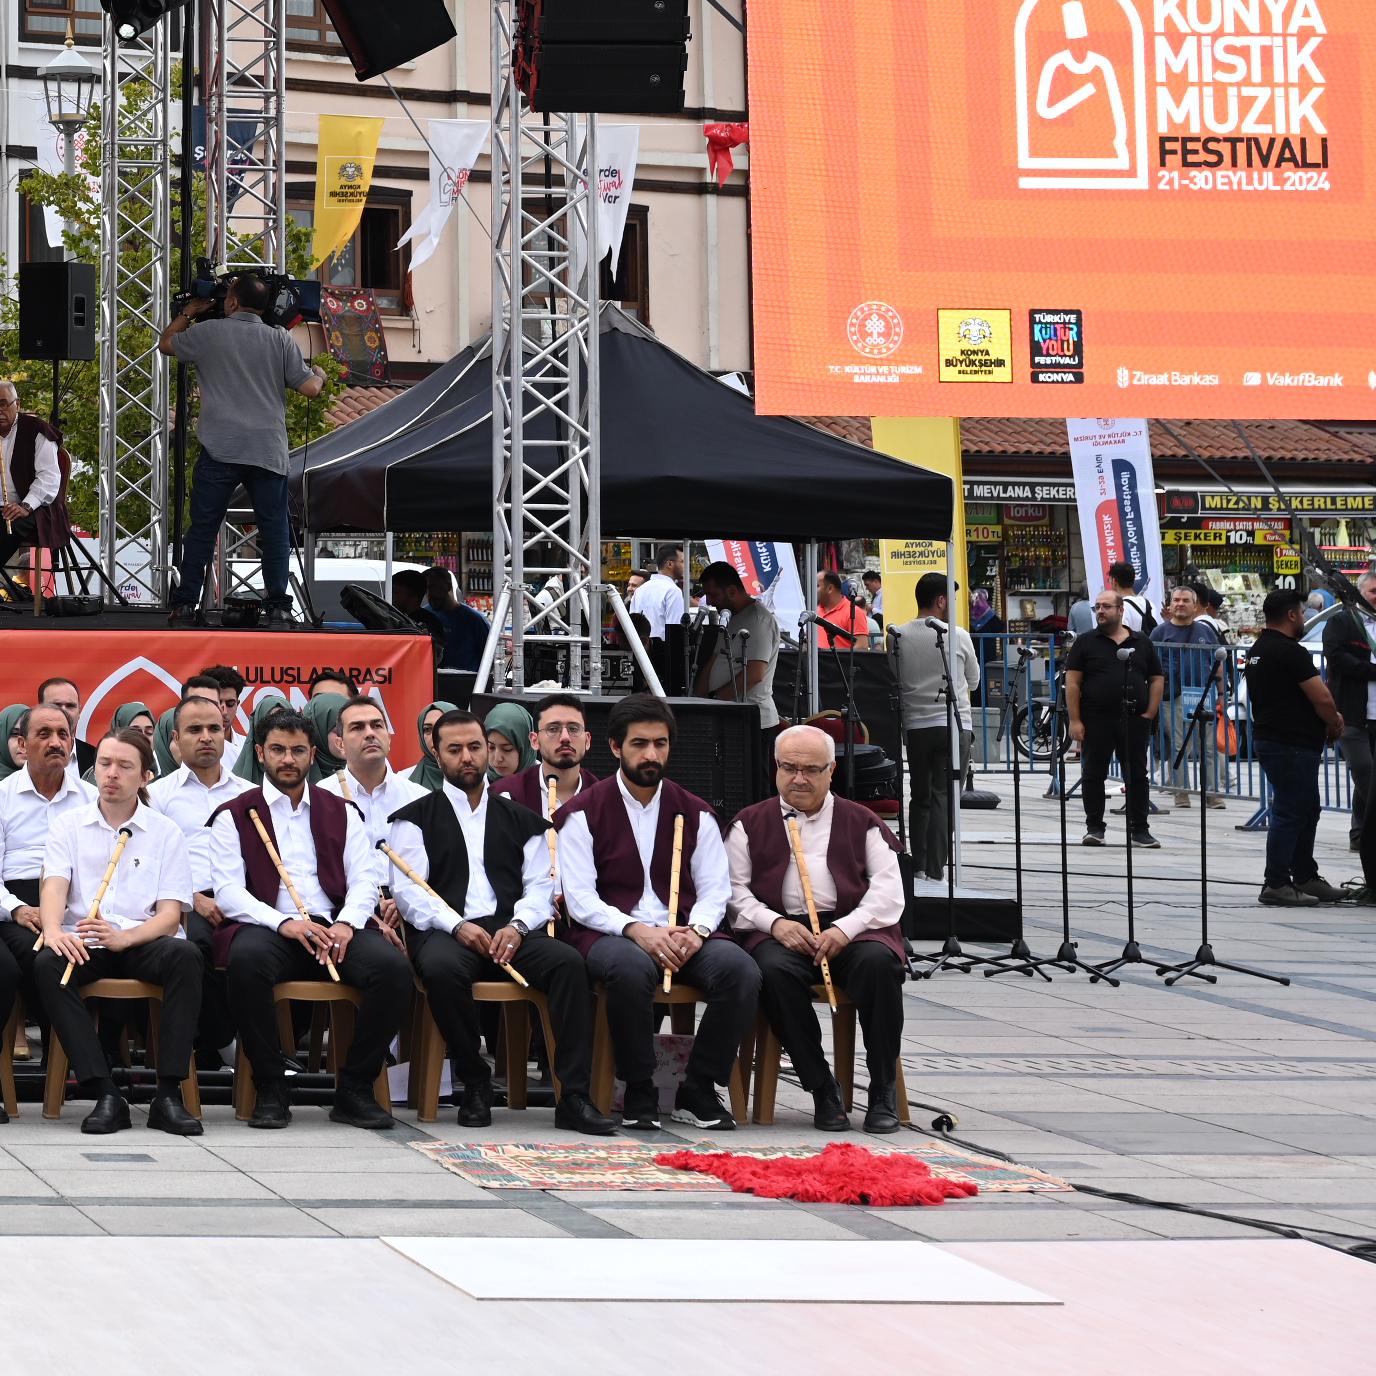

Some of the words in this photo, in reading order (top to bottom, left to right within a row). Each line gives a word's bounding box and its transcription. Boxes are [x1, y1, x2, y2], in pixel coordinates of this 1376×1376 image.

[1157, 171, 1213, 190] 21-30
[1282, 171, 1331, 191] 2024
[1033, 312, 1077, 323] TÜRKİYE
[1033, 324, 1078, 342] KÜLTÜR
[960, 348, 990, 357] KONYA
[1040, 339, 1073, 356] YOLU
[945, 357, 1006, 369] BÜYÜKŞEHİR
[1038, 372, 1075, 382] KONYA
[1132, 372, 1169, 386] Ziraat
[1171, 372, 1218, 386] Bankası
[974, 484, 1031, 499] MEVLANA
[1034, 484, 1077, 501] ŞEKER
[1173, 531, 1223, 544] ŞEKER
[1275, 558, 1299, 571] ŞEKER
